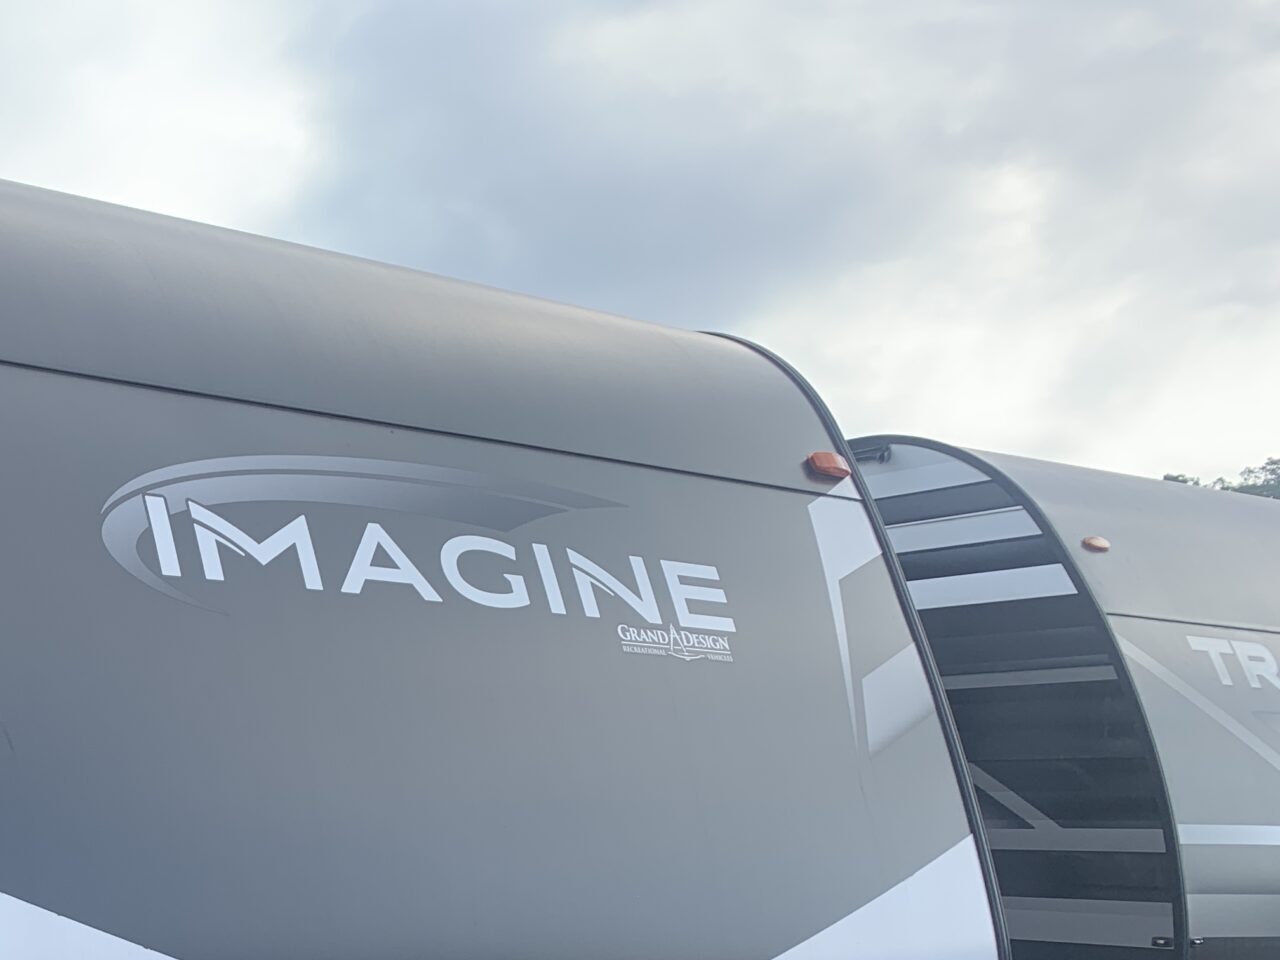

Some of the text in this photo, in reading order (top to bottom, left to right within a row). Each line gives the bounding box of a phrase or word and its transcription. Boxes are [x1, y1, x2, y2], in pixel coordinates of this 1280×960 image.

[144, 494, 736, 632] IMAGINE
[617, 624, 730, 650] GRAND DESIGN
